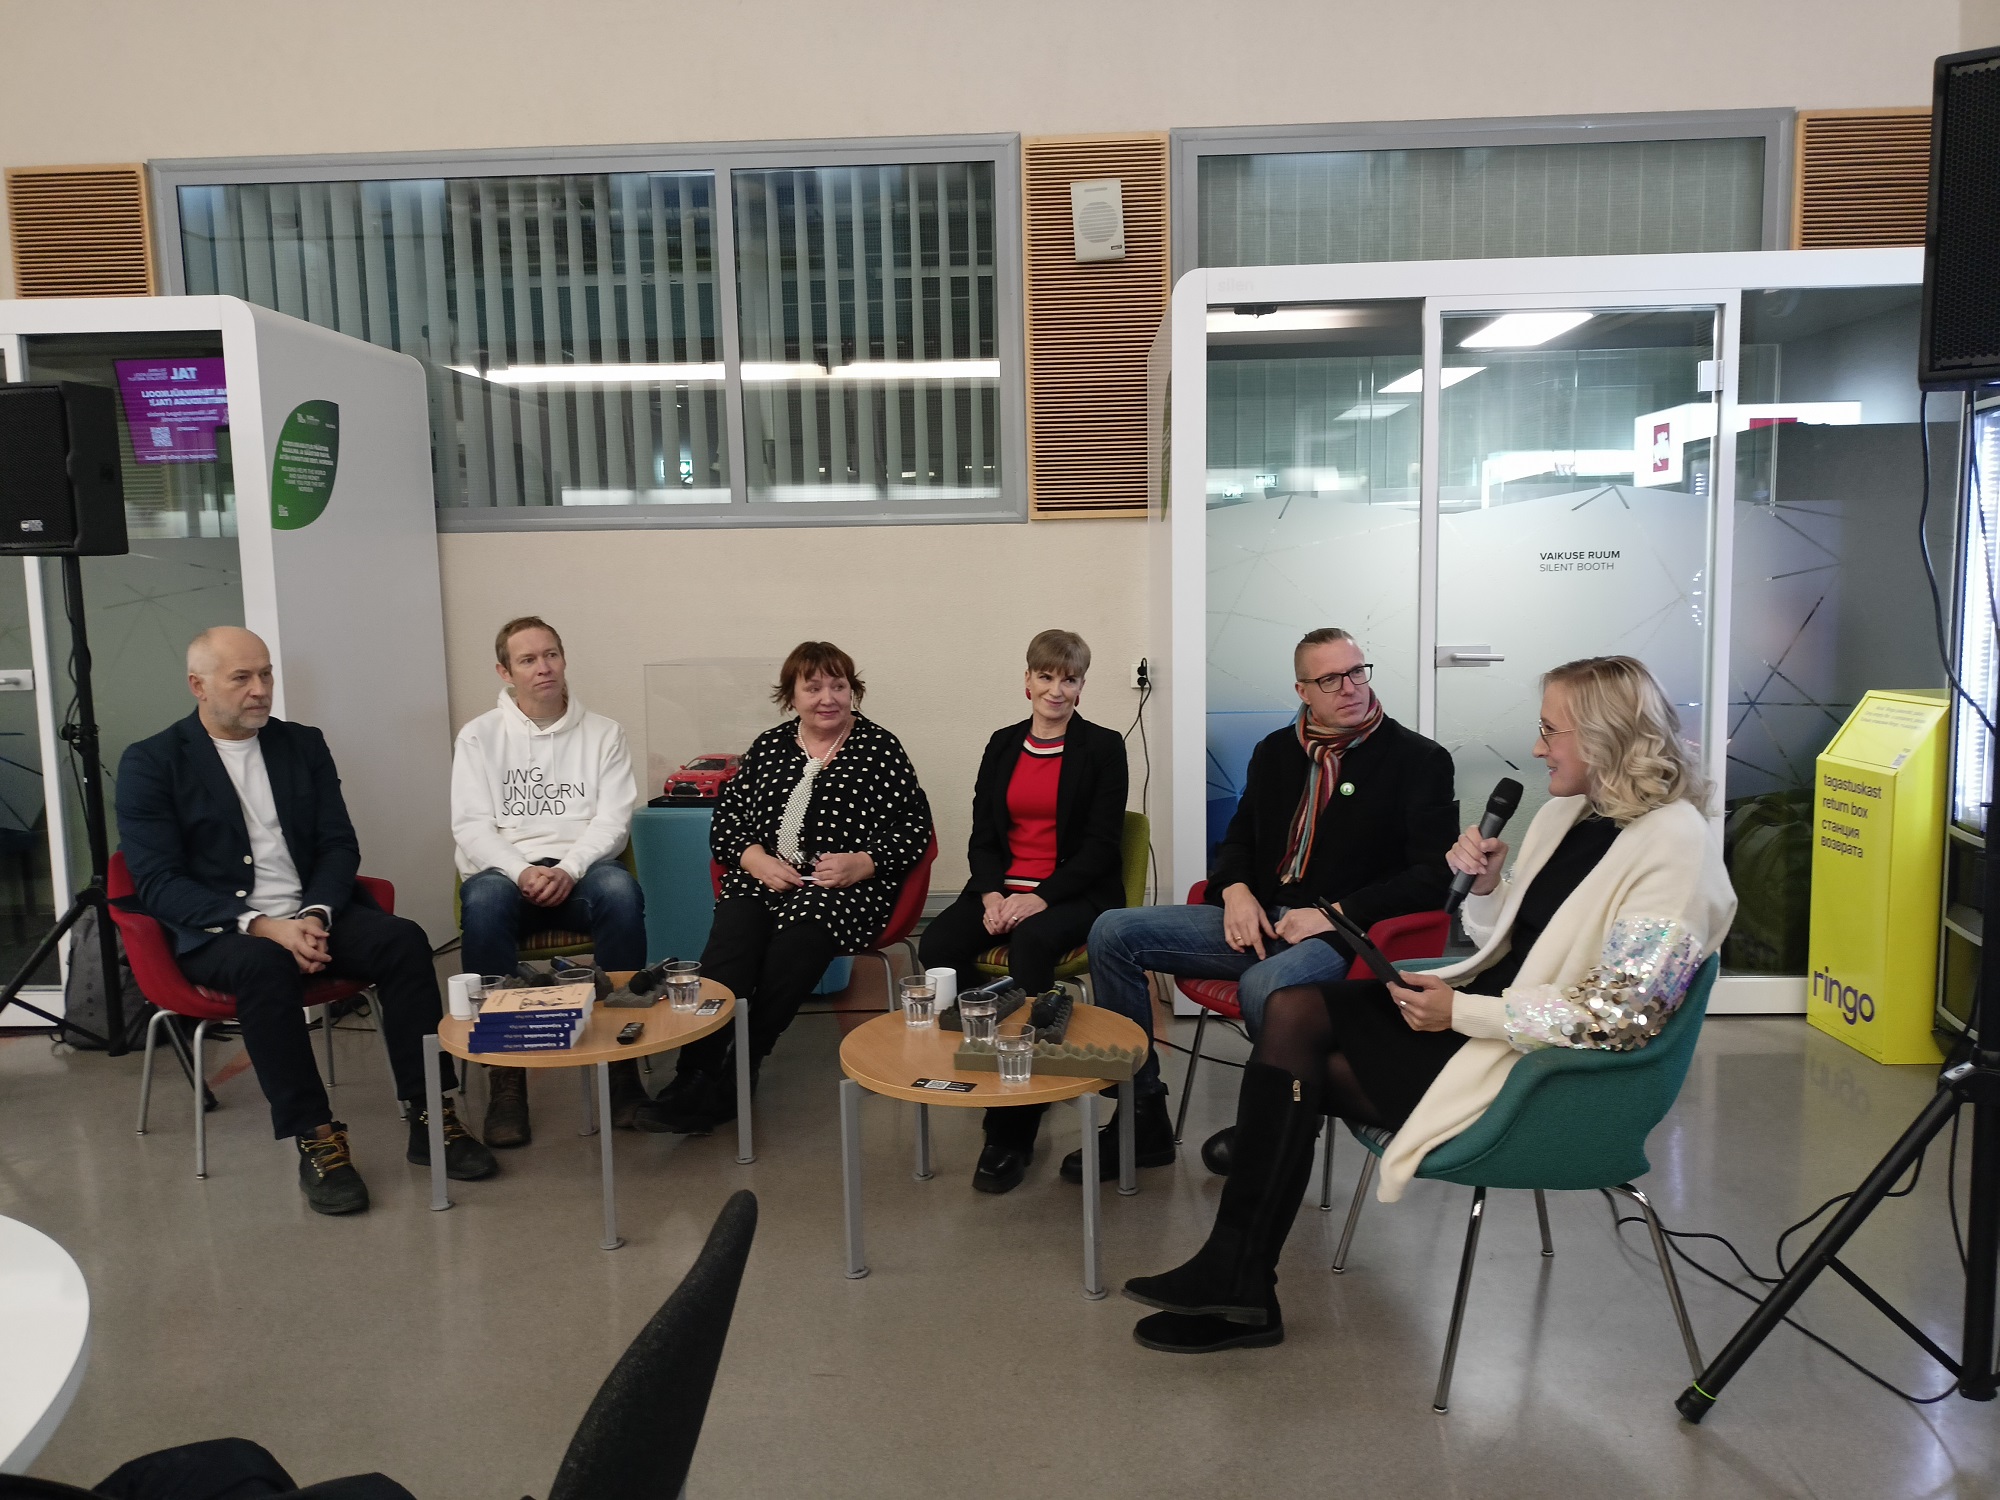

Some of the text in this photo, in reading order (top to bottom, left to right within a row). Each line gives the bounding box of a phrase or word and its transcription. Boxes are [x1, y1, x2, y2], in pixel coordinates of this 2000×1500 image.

[1540, 551, 1620, 560] VAIKUSE RUUM
[1540, 562, 1614, 572] SILENT BOOTH
[503, 782, 585, 801] UNICORN
[1823, 774, 1882, 799] tagastuskast
[502, 800, 566, 816] SQUAD
[1822, 797, 1868, 819] return box
[1822, 819, 1860, 839] станция
[1821, 836, 1863, 858] возврата
[1813, 966, 1875, 1026] ringo
